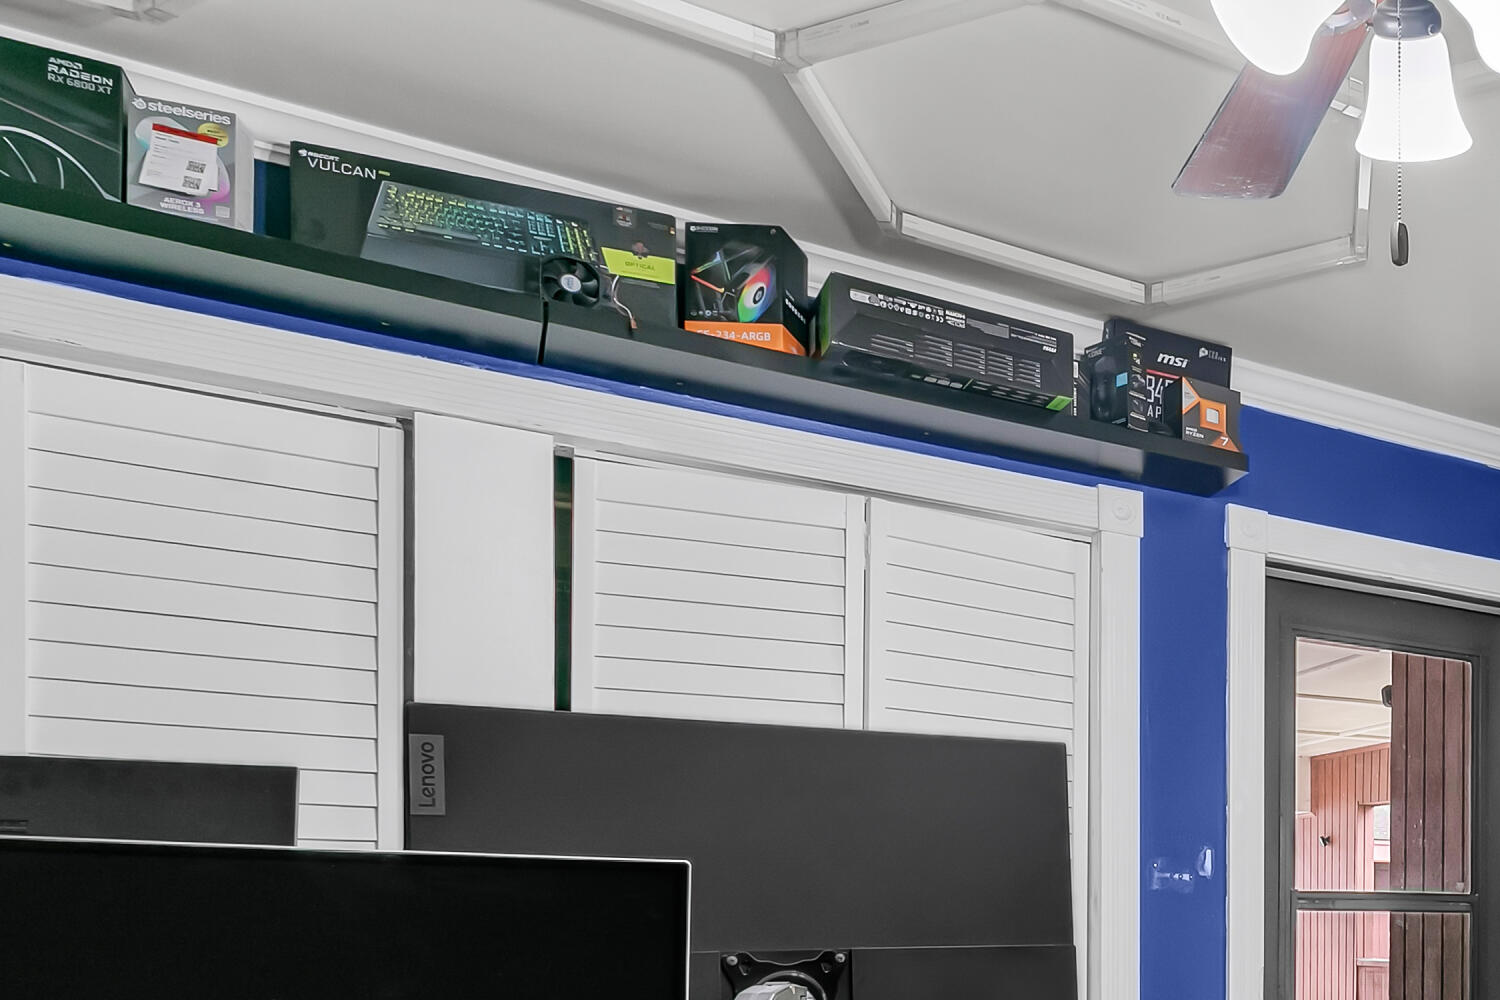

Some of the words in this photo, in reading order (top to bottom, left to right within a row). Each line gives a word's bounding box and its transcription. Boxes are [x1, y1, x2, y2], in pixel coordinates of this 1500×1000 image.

[48, 57, 75, 69] AMD
[48, 64, 113, 86] RADEON
[48, 73, 64, 83] RX
[66, 78, 96, 93] 6800
[97, 85, 112, 95] XT
[147, 101, 231, 125] steelseries
[307, 157, 376, 180] VULCAN
[160, 201, 204, 214] WIRELESS
[1157, 353, 1189, 368] msi
[1220, 436, 1229, 446] 7
[418, 741, 436, 807] Lenovo
